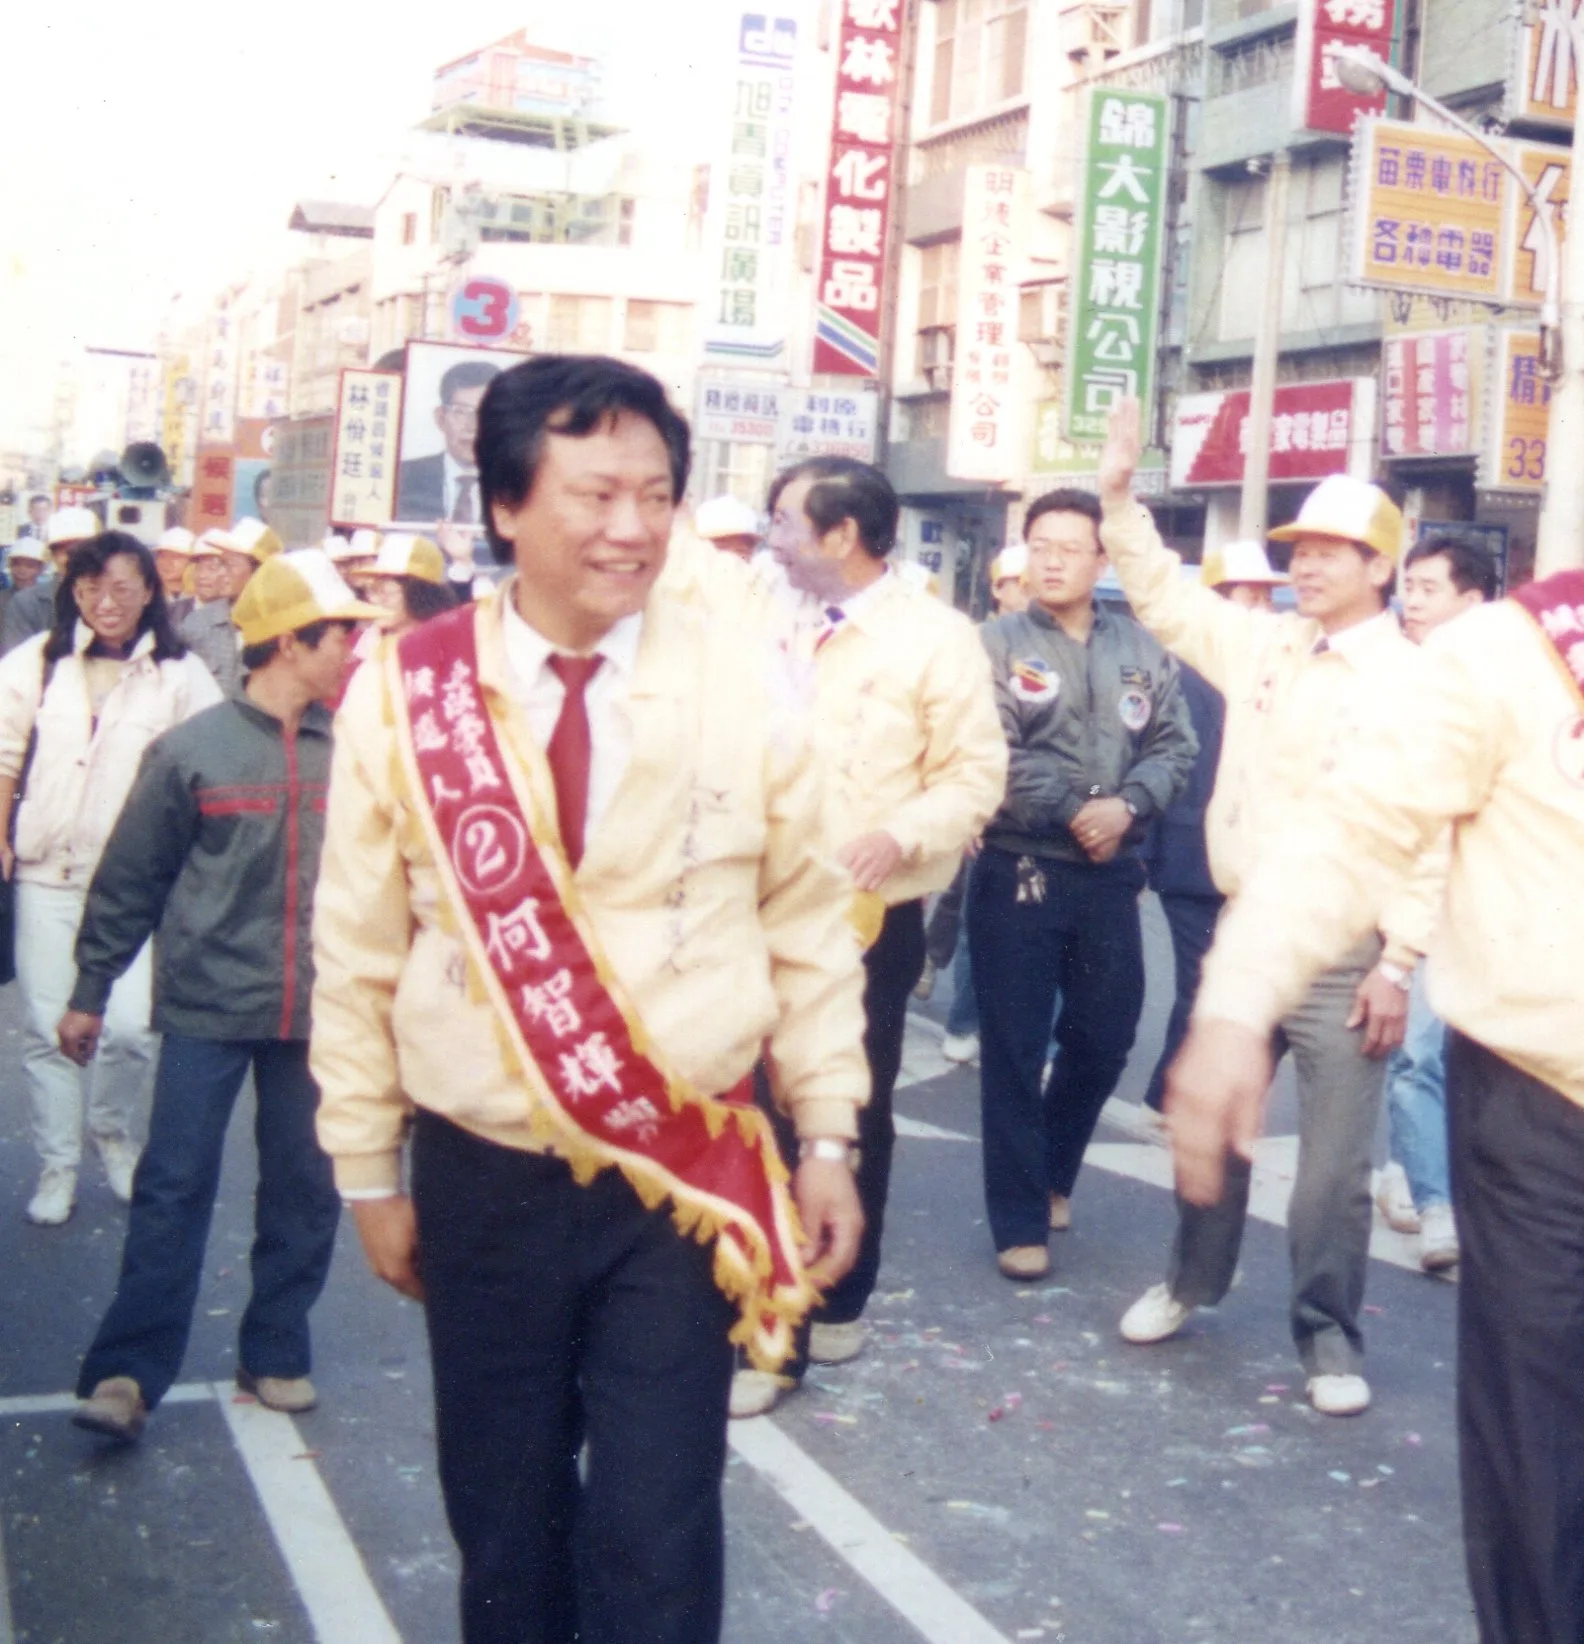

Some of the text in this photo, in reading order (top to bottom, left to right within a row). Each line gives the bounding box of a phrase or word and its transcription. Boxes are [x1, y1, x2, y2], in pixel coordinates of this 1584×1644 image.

[1080, 97, 1157, 413] 錦大影視公司
[1373, 218, 1494, 276] 各種電器
[460, 279, 510, 337] 3
[1239, 409, 1349, 455] 家電製品
[441, 657, 503, 796] 立法委員
[482, 895, 624, 1100] 何智輝
